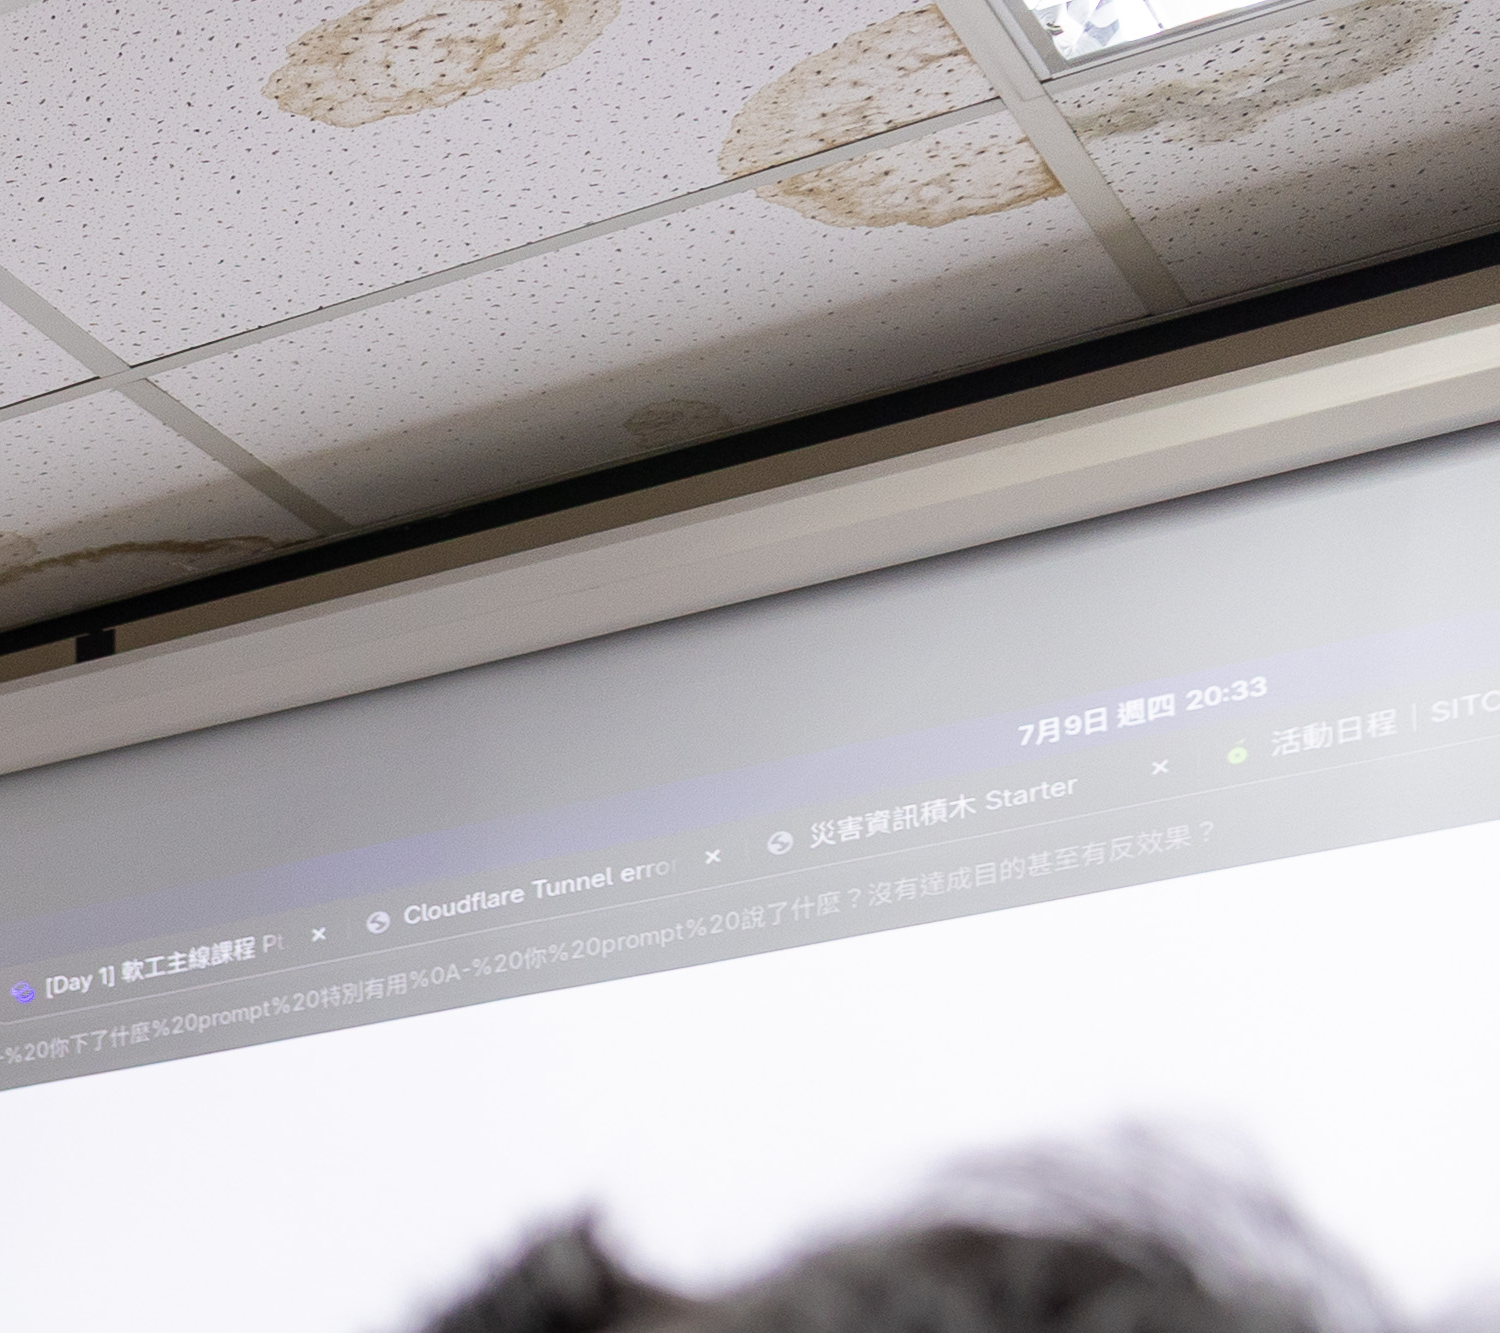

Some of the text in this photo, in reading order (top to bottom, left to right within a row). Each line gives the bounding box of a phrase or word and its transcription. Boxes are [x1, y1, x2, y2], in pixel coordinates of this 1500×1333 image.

[1016, 676, 1269, 748] 7月9日 週四 20:33
[1270, 708, 1398, 757] 活動日程
[809, 776, 1079, 850] 災害資訊積木 Starter
[403, 885, 526, 927] Cloudflare
[531, 867, 614, 901] Tunnel
[45, 971, 93, 1000] [Day
[99, 966, 116, 988] 1]
